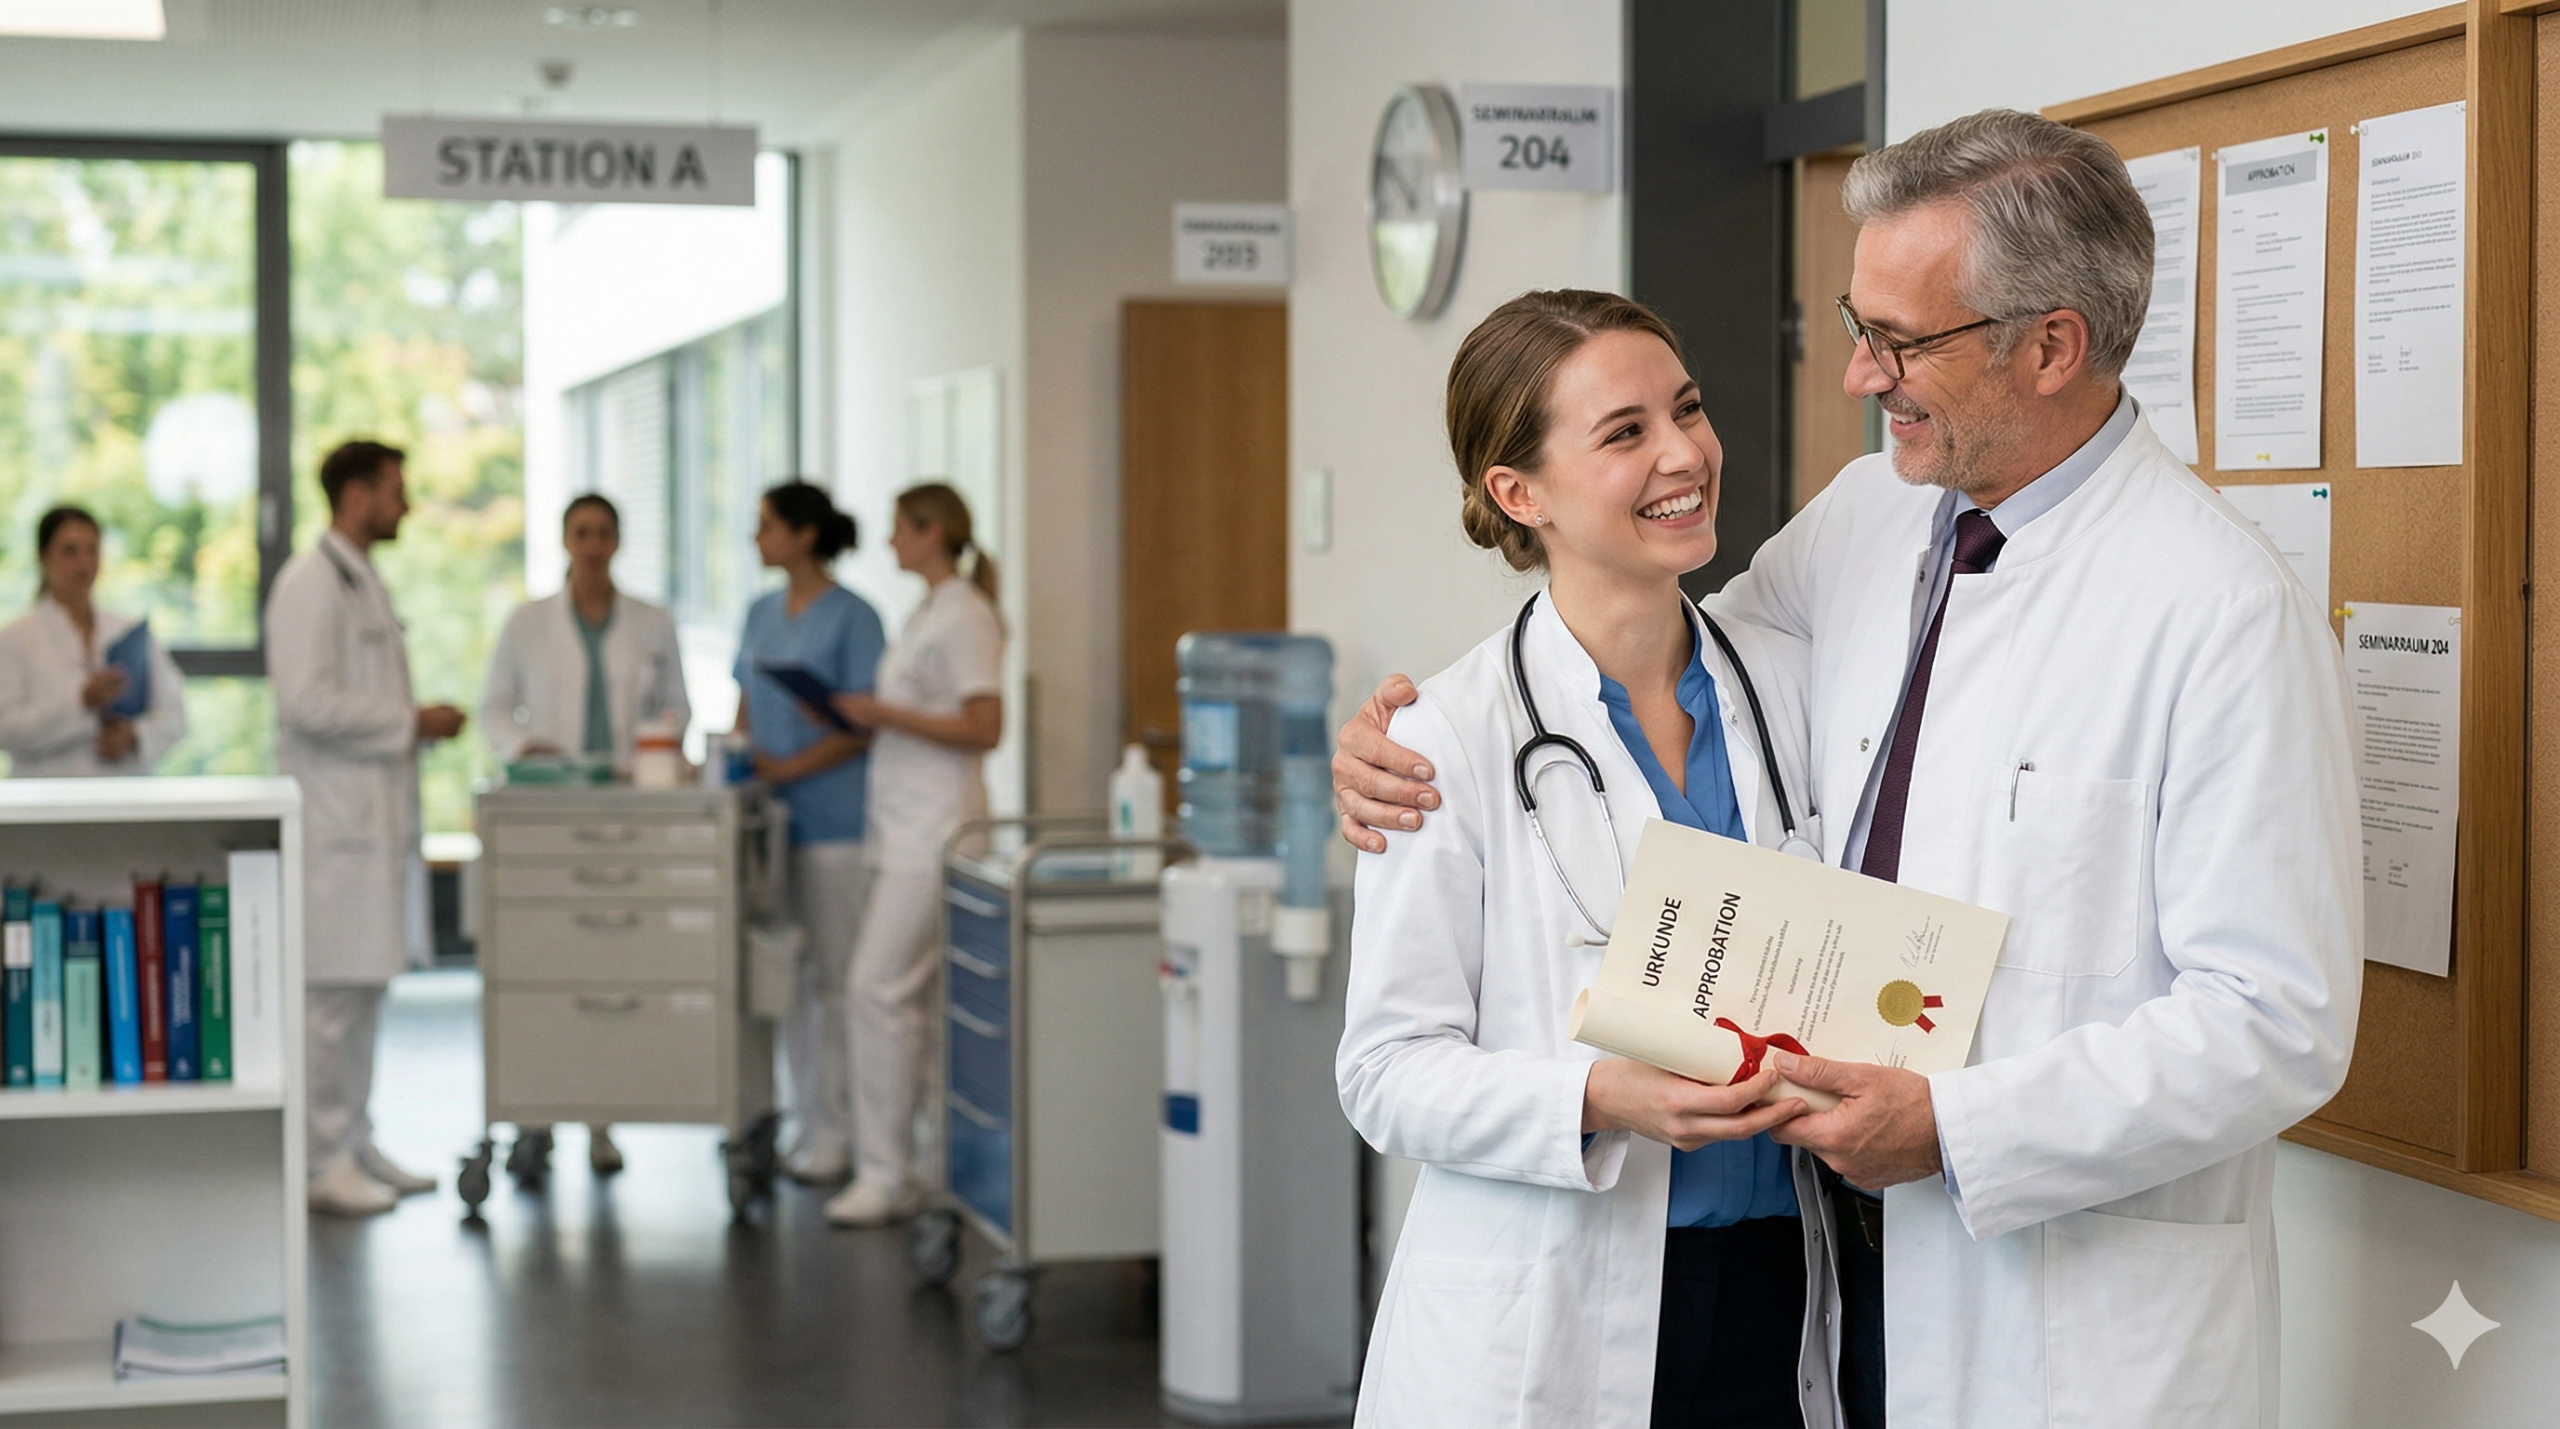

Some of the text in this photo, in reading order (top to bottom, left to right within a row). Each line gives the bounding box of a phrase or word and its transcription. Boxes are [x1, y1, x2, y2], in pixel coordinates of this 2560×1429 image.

[438, 137, 706, 188] STATION A
[1499, 134, 1572, 172] 204
[2359, 633, 2449, 655] SEMINARRAUM 204
[1642, 897, 1682, 987] URKUNDE
[1692, 892, 1741, 1020] APPROBATION
